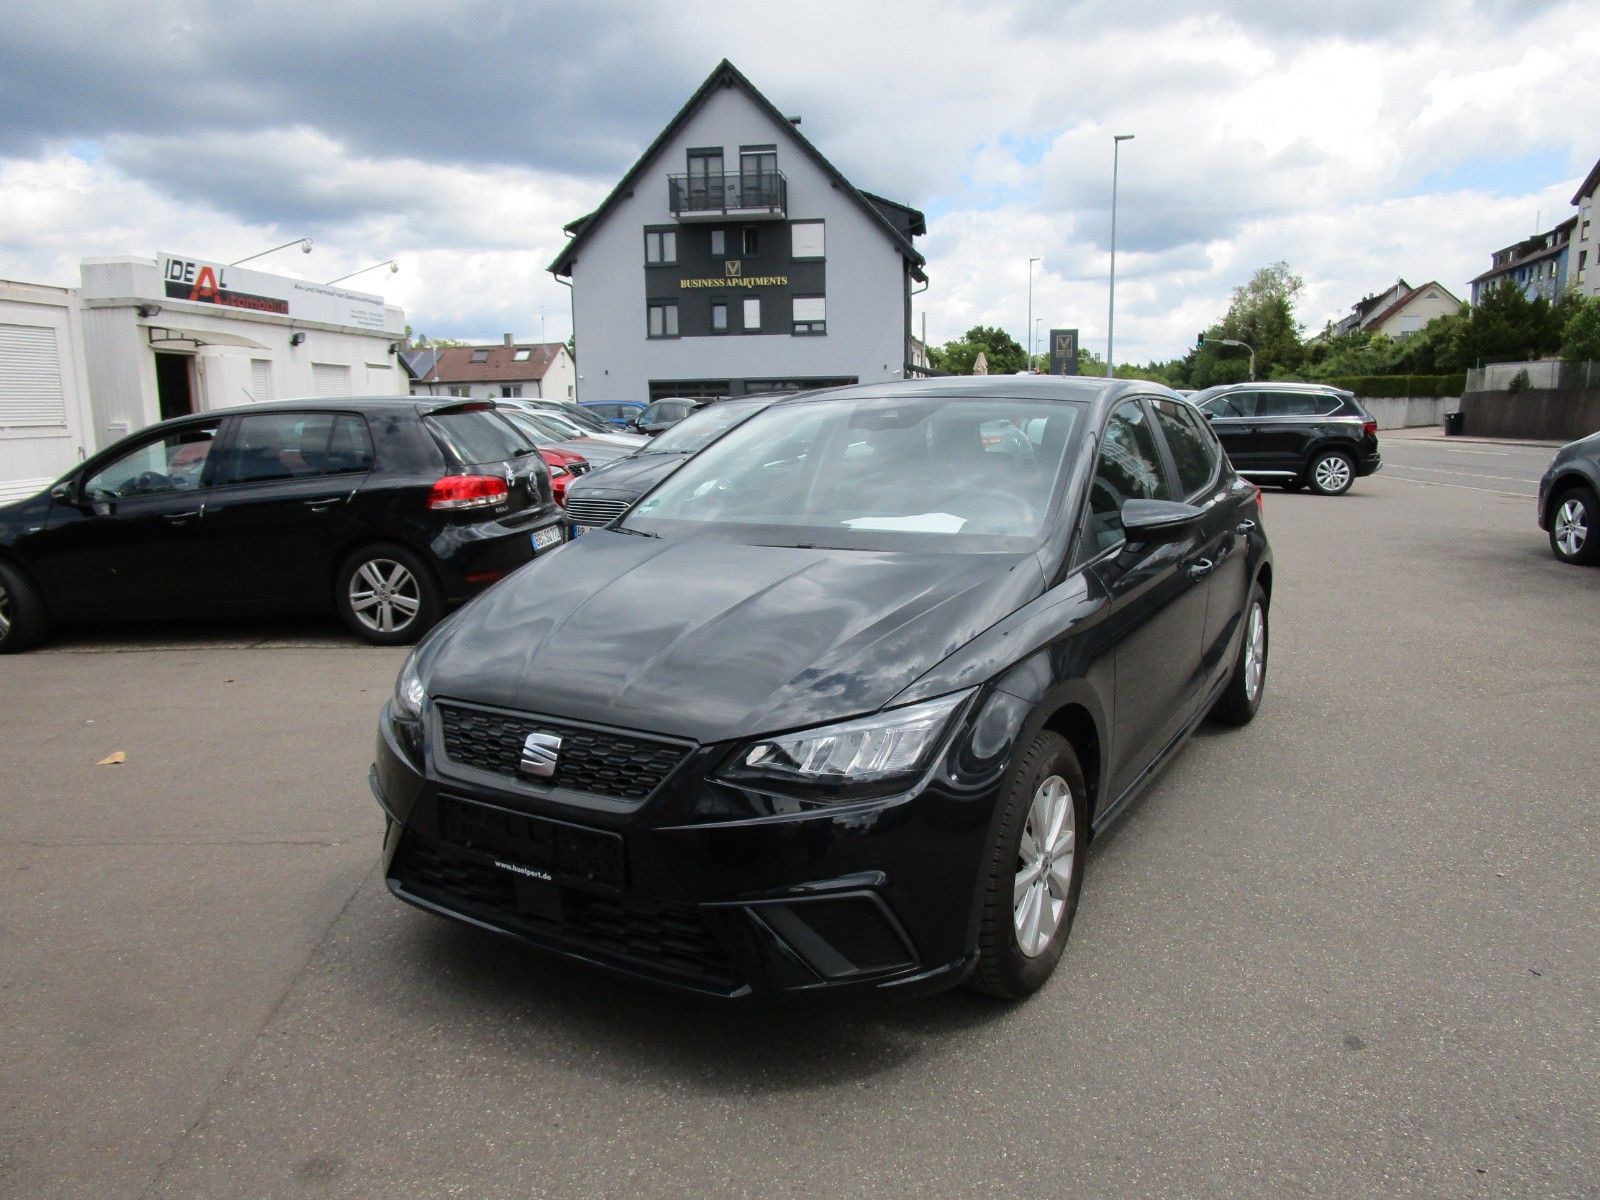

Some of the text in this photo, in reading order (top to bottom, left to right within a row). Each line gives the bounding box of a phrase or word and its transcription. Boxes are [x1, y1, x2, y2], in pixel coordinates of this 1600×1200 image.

[164, 258, 227, 304] IDEAL
[680, 276, 788, 289] BUSINESS APARTMENTS
